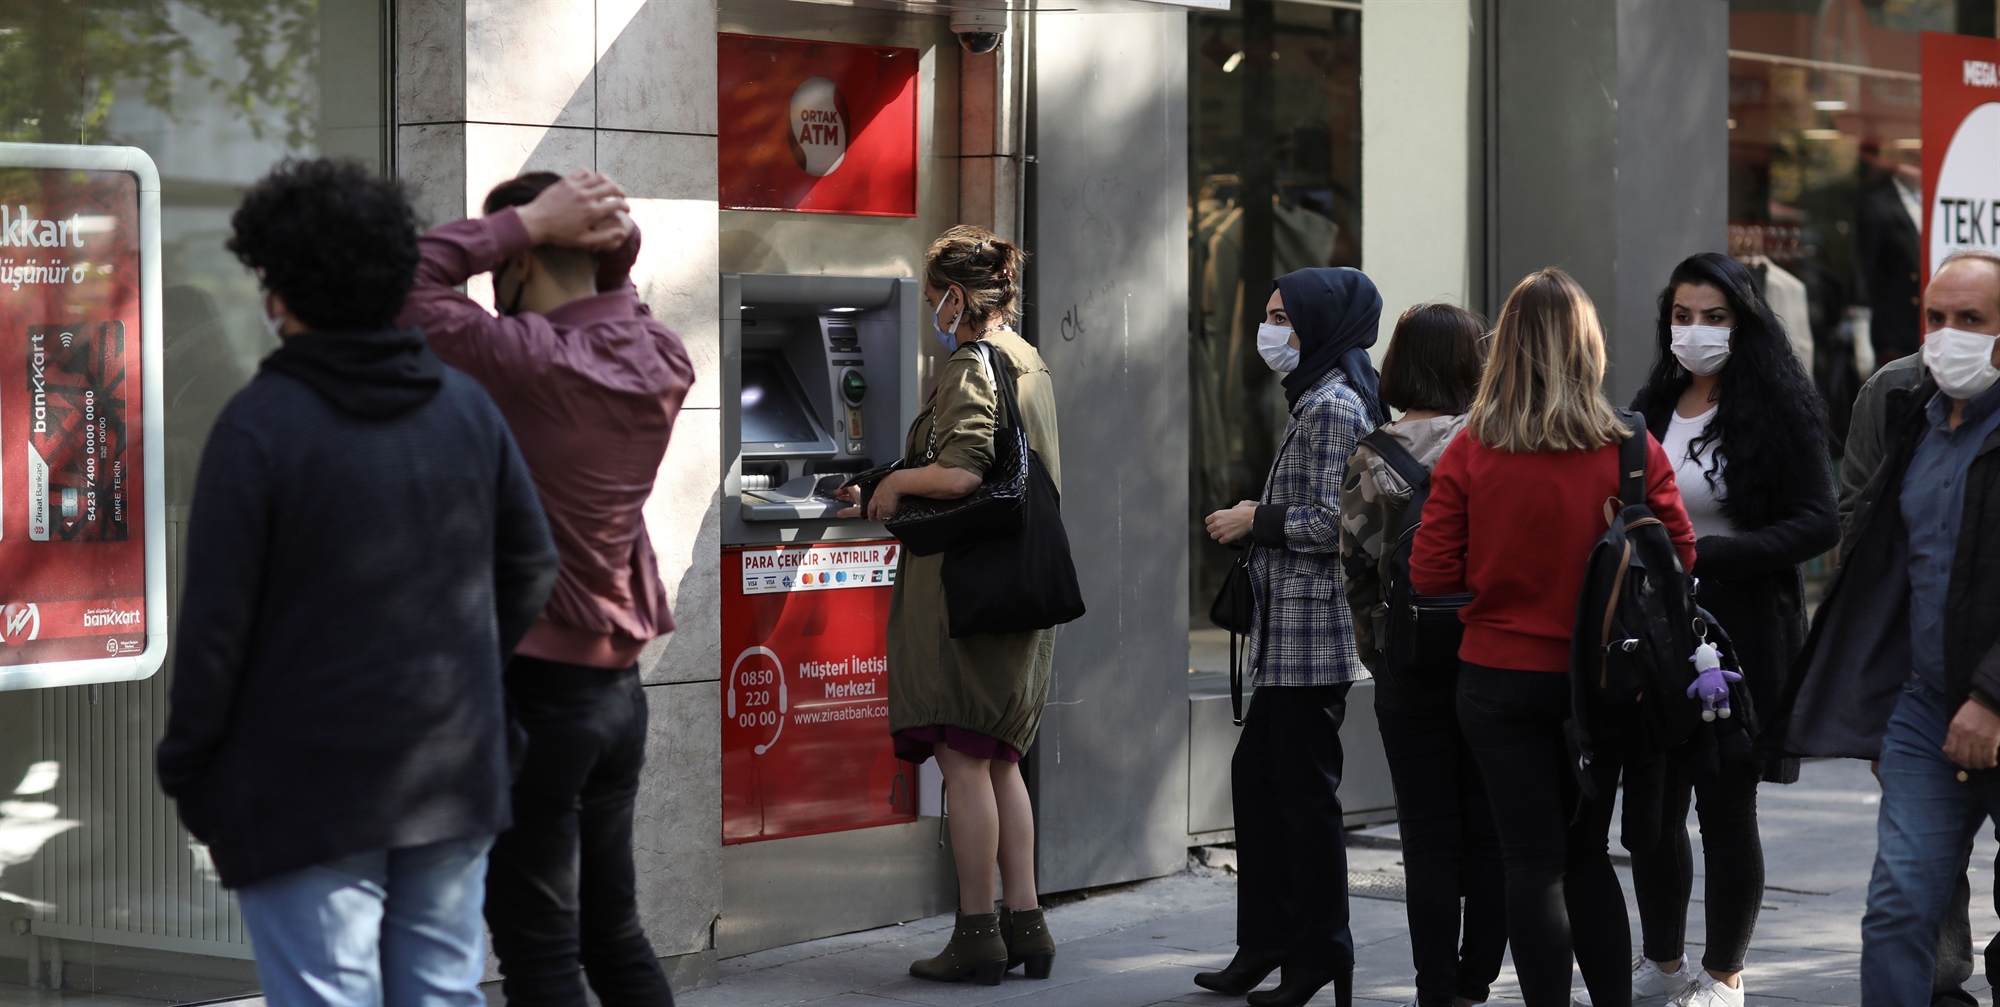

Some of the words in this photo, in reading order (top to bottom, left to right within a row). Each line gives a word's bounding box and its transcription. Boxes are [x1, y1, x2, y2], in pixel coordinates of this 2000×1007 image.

[1963, 59, 1998, 88] MEGA
[801, 109, 838, 124] ORTAK
[799, 123, 839, 146] ATM
[0, 204, 85, 248] kkart
[1939, 198, 1986, 246] TEK
[0, 257, 70, 291] üşünür
[71, 266, 85, 284] o
[85, 390, 94, 420] 0000
[86, 424, 95, 454] 0000
[34, 462, 43, 497] Bankası
[86, 458, 95, 487] 7400
[113, 461, 121, 490] TEKİN
[34, 497, 43, 524] Ziraat
[87, 491, 96, 521] 5423
[745, 554, 774, 570] PARA
[777, 551, 819, 571] ÇEKİLİR
[829, 550, 880, 565] YATIRILIR
[852, 572, 866, 583] troy
[740, 669, 774, 687] 0850
[799, 658, 848, 680] Müşteri
[852, 654, 888, 675] İletişi
[745, 690, 770, 707] 220
[825, 678, 876, 699] Merkezi
[739, 712, 758, 728] 00
[758, 710, 776, 726] 00
[794, 704, 888, 725] www.ziraatbank.co
